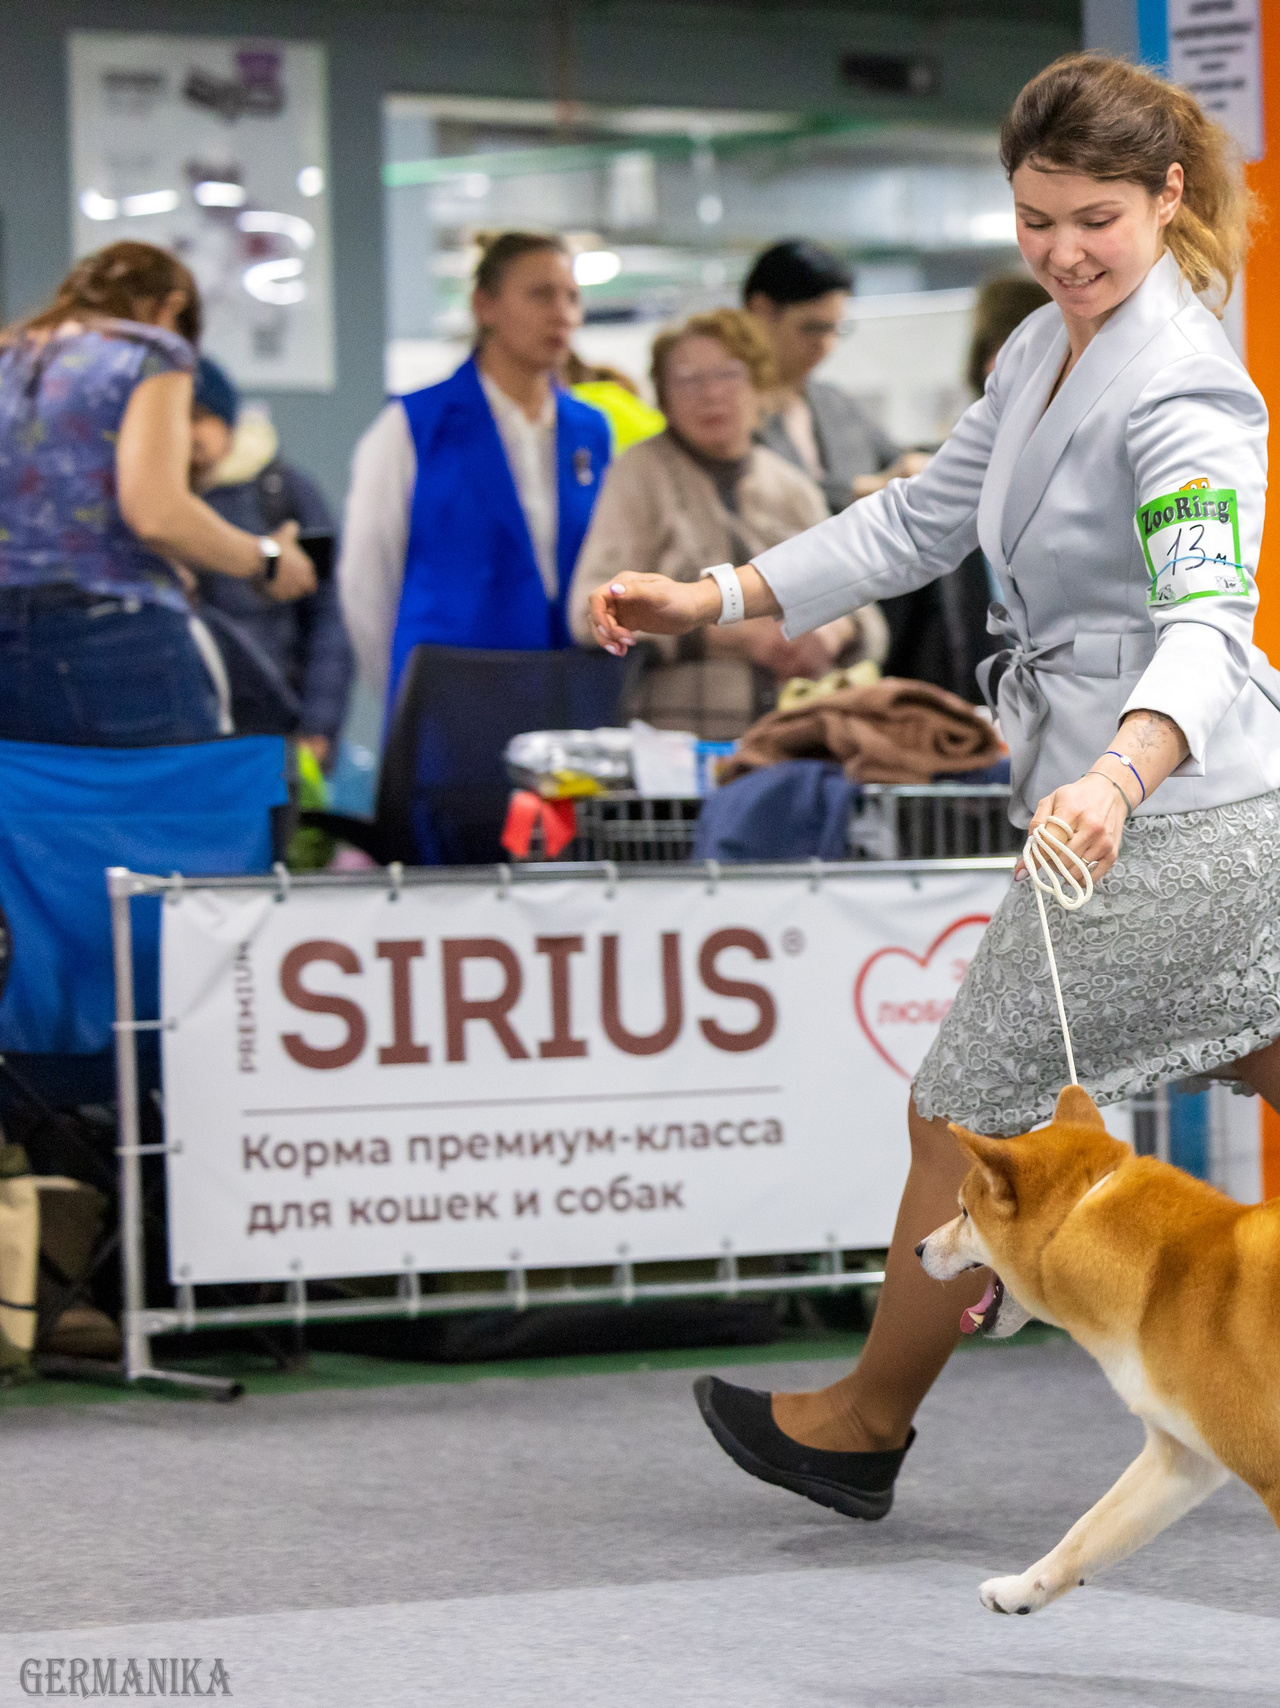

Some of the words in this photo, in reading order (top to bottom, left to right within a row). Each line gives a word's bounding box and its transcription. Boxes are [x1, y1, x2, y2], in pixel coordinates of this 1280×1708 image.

[1141, 495, 1230, 535] ZooRing
[1167, 524, 1206, 575] 13
[242, 1134, 391, 1177] Корма
[407, 1117, 784, 1171] премиум-класса
[247, 1200, 333, 1237] для
[350, 1192, 498, 1225] кошек
[514, 1190, 539, 1216] и
[556, 1173, 684, 1214] собак
